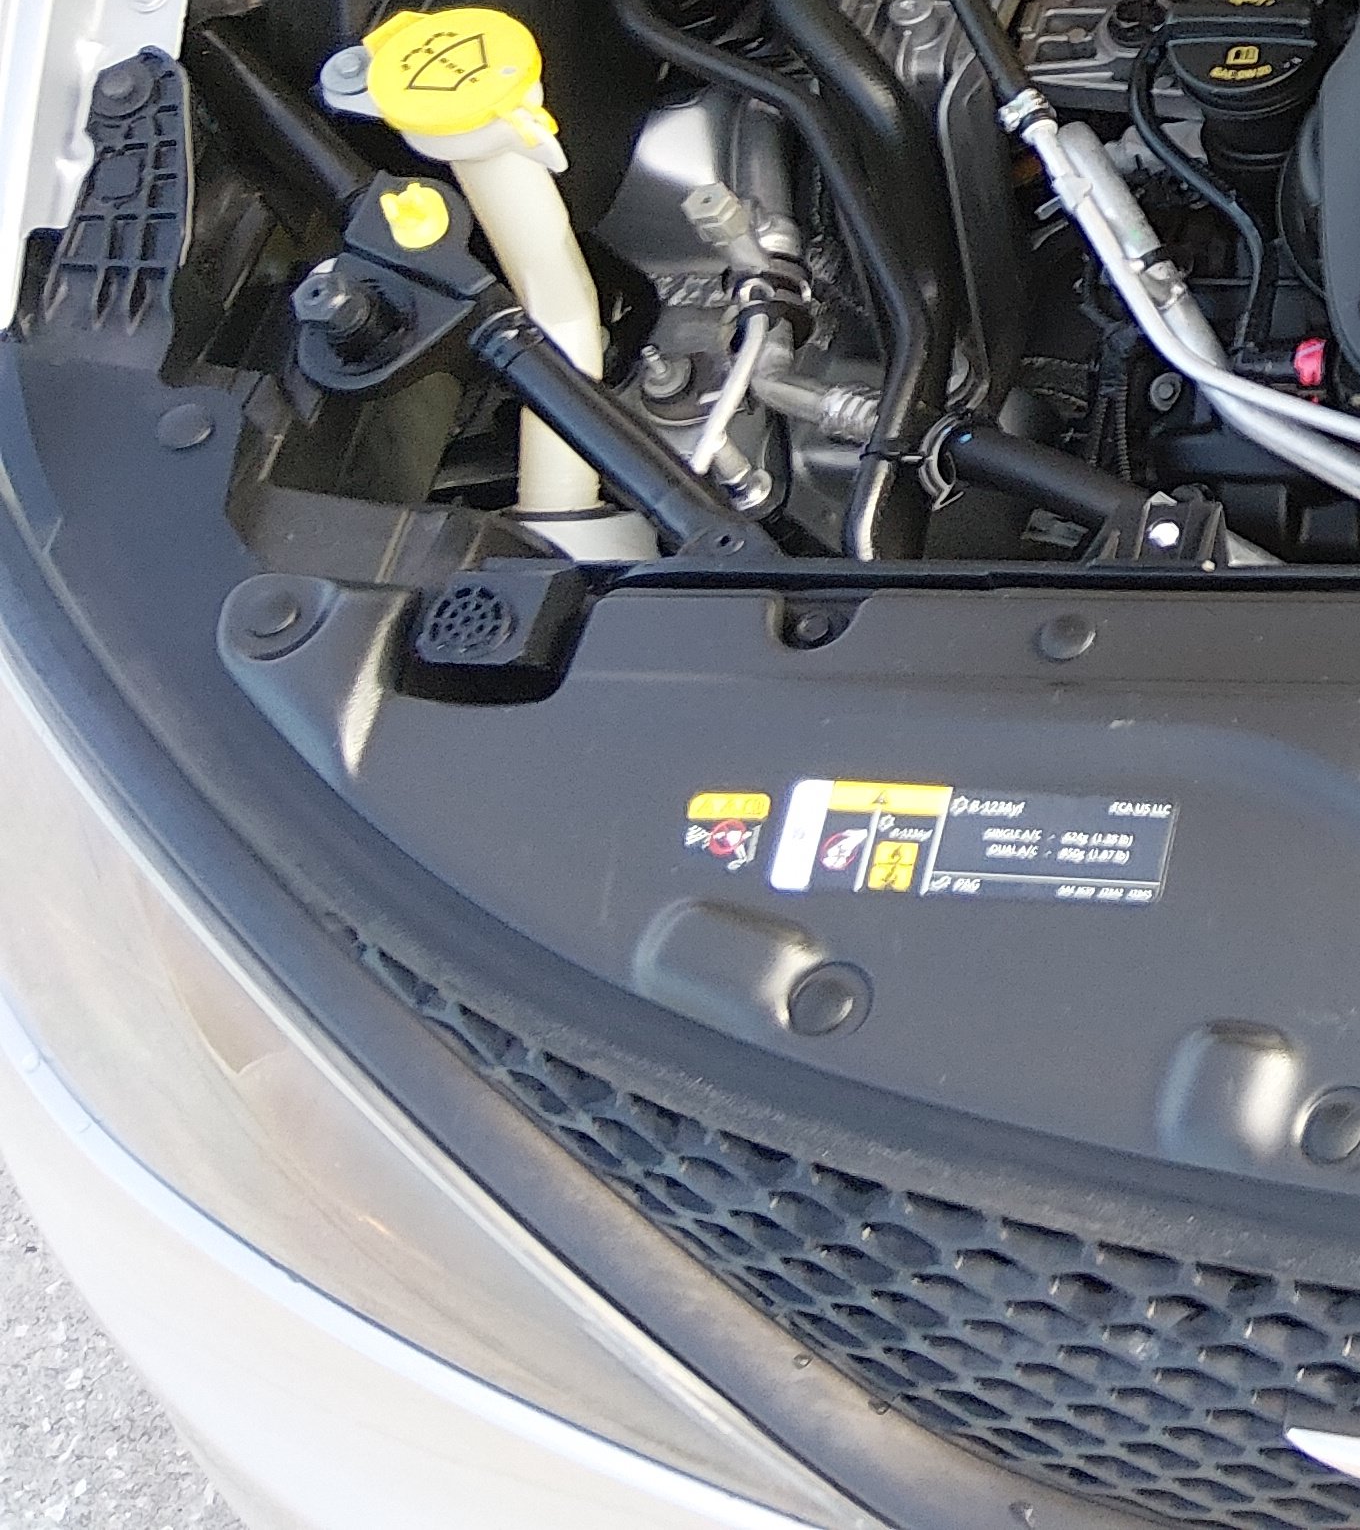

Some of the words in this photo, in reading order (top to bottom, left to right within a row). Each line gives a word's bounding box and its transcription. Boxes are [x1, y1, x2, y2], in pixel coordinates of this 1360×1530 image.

[1109, 801, 1133, 817] FCA
[1132, 802, 1151, 817] US
[1150, 804, 1172, 818] LLC
[983, 828, 1022, 843] SINGLE
[1020, 829, 1043, 843] A/C
[986, 844, 1017, 858] DUAL
[1014, 845, 1040, 860] A/C
[952, 878, 981, 894] PAG
